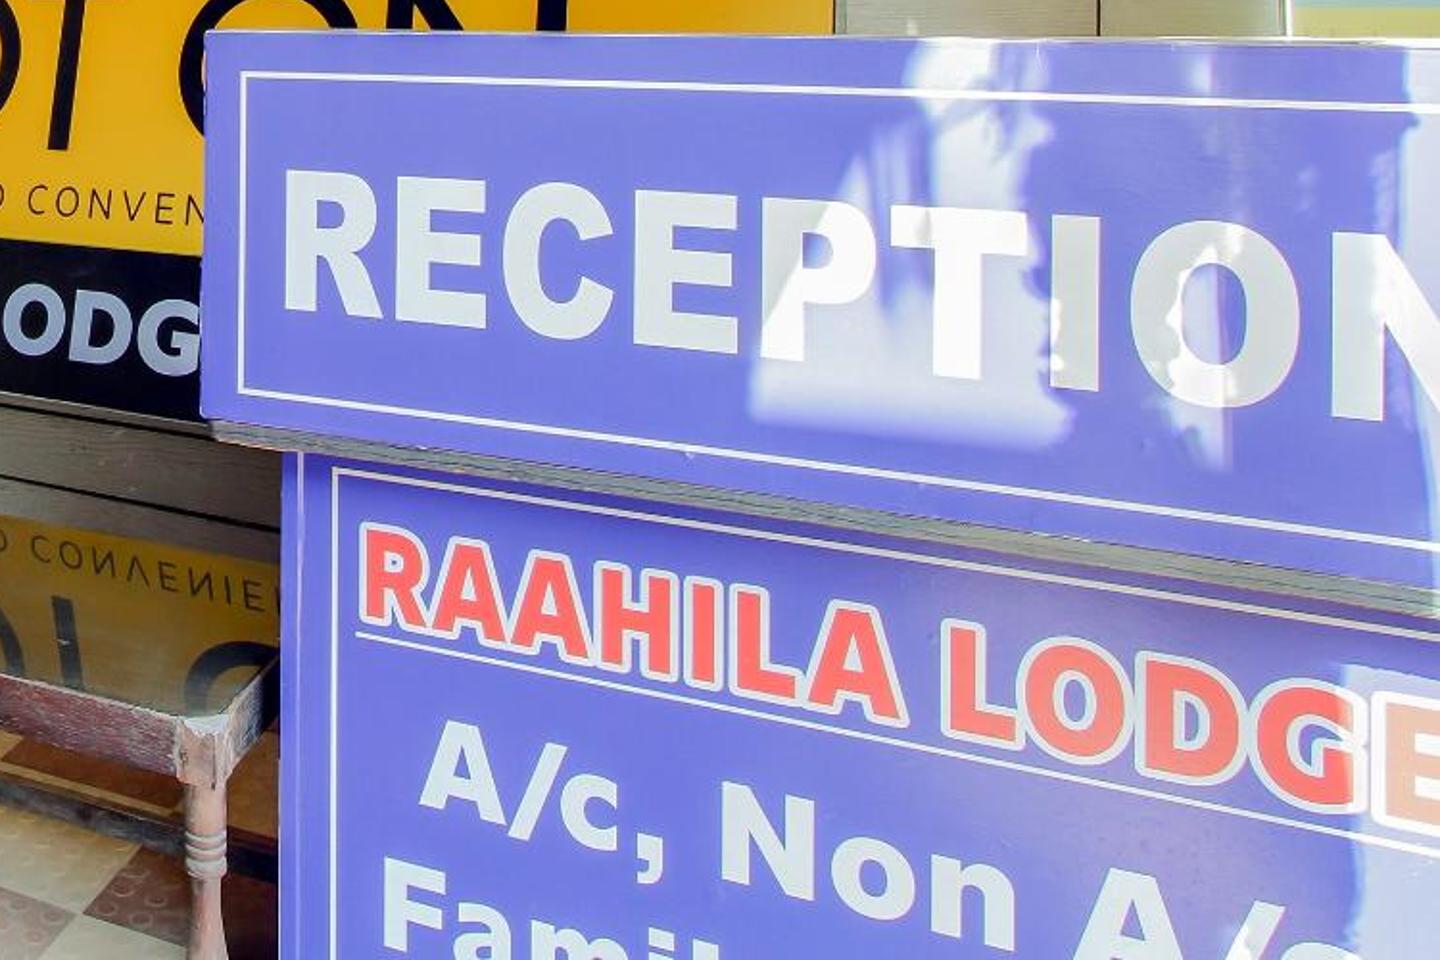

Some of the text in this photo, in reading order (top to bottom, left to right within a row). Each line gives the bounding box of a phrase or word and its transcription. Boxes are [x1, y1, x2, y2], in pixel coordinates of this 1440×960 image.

[284, 169, 1440, 422] RECEPTION
[358, 521, 1440, 839] RAAHILA LODGE
[418, 719, 665, 885] A/c,
[720, 780, 1016, 952] Non
